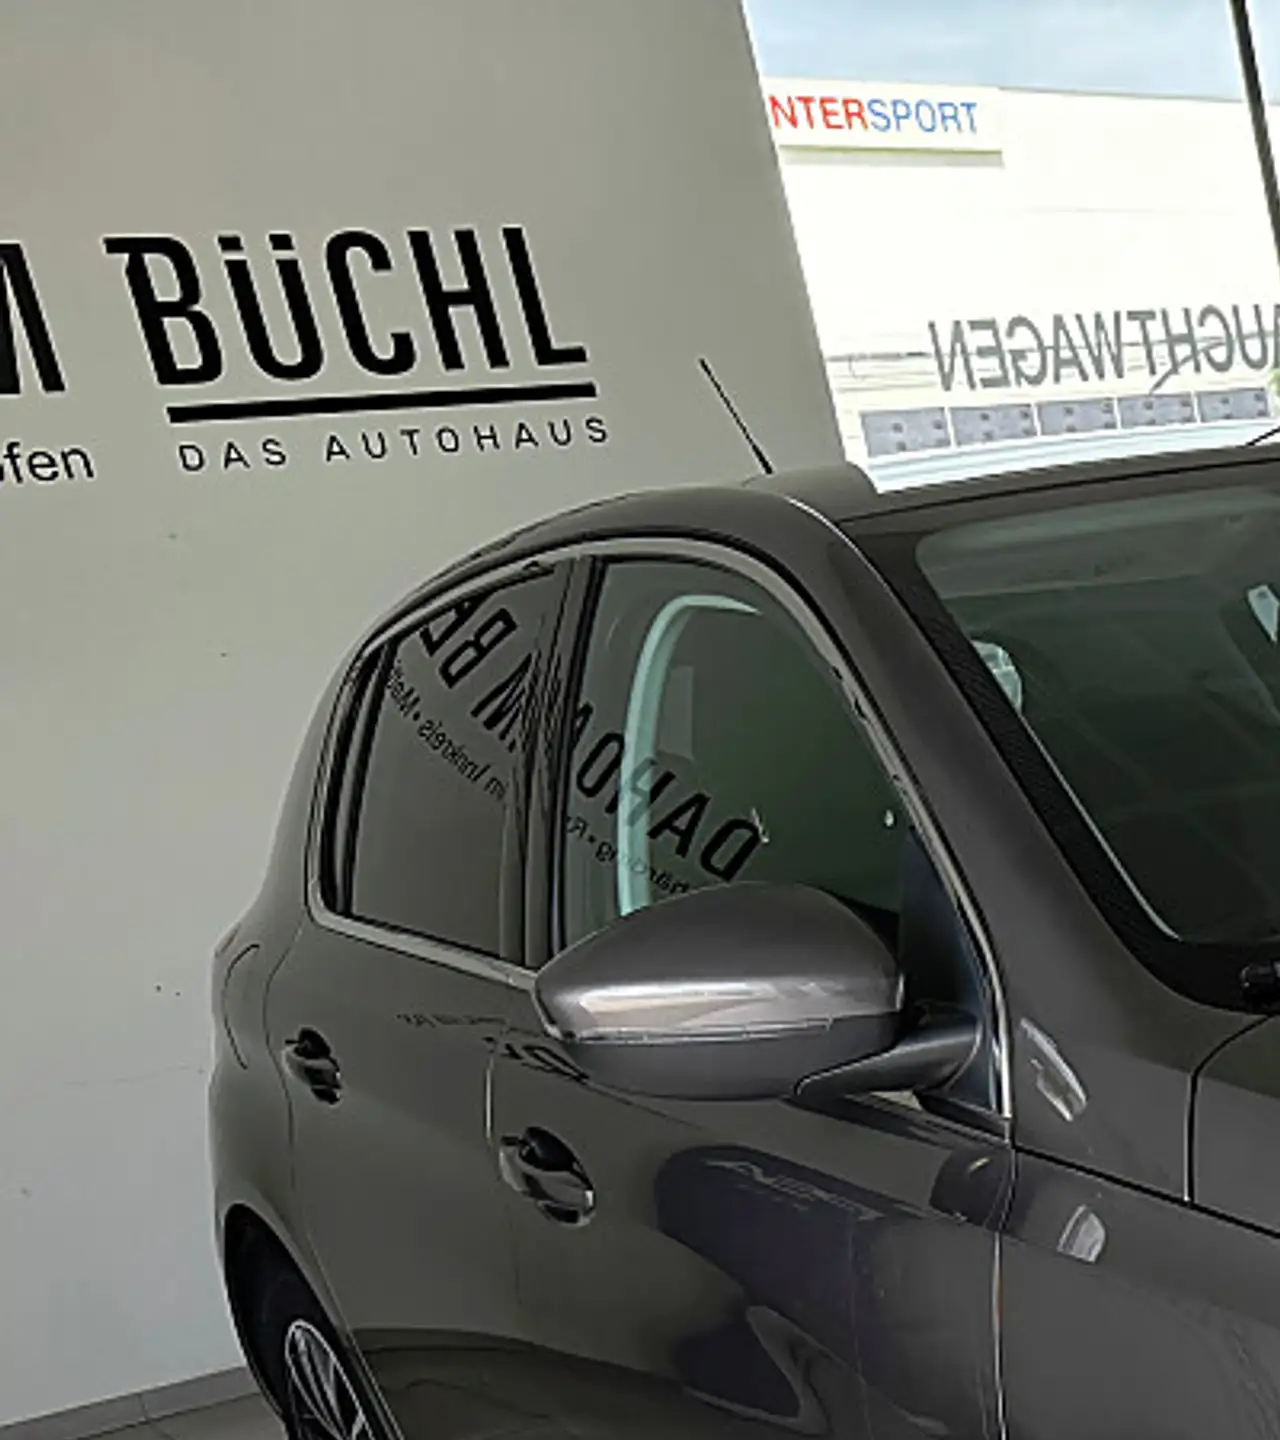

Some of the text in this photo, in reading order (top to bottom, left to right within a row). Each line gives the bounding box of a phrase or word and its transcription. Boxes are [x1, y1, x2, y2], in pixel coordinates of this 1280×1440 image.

[103, 226, 588, 386] BÜCHL
[179, 416, 611, 472] DAS AUTOHAUS
